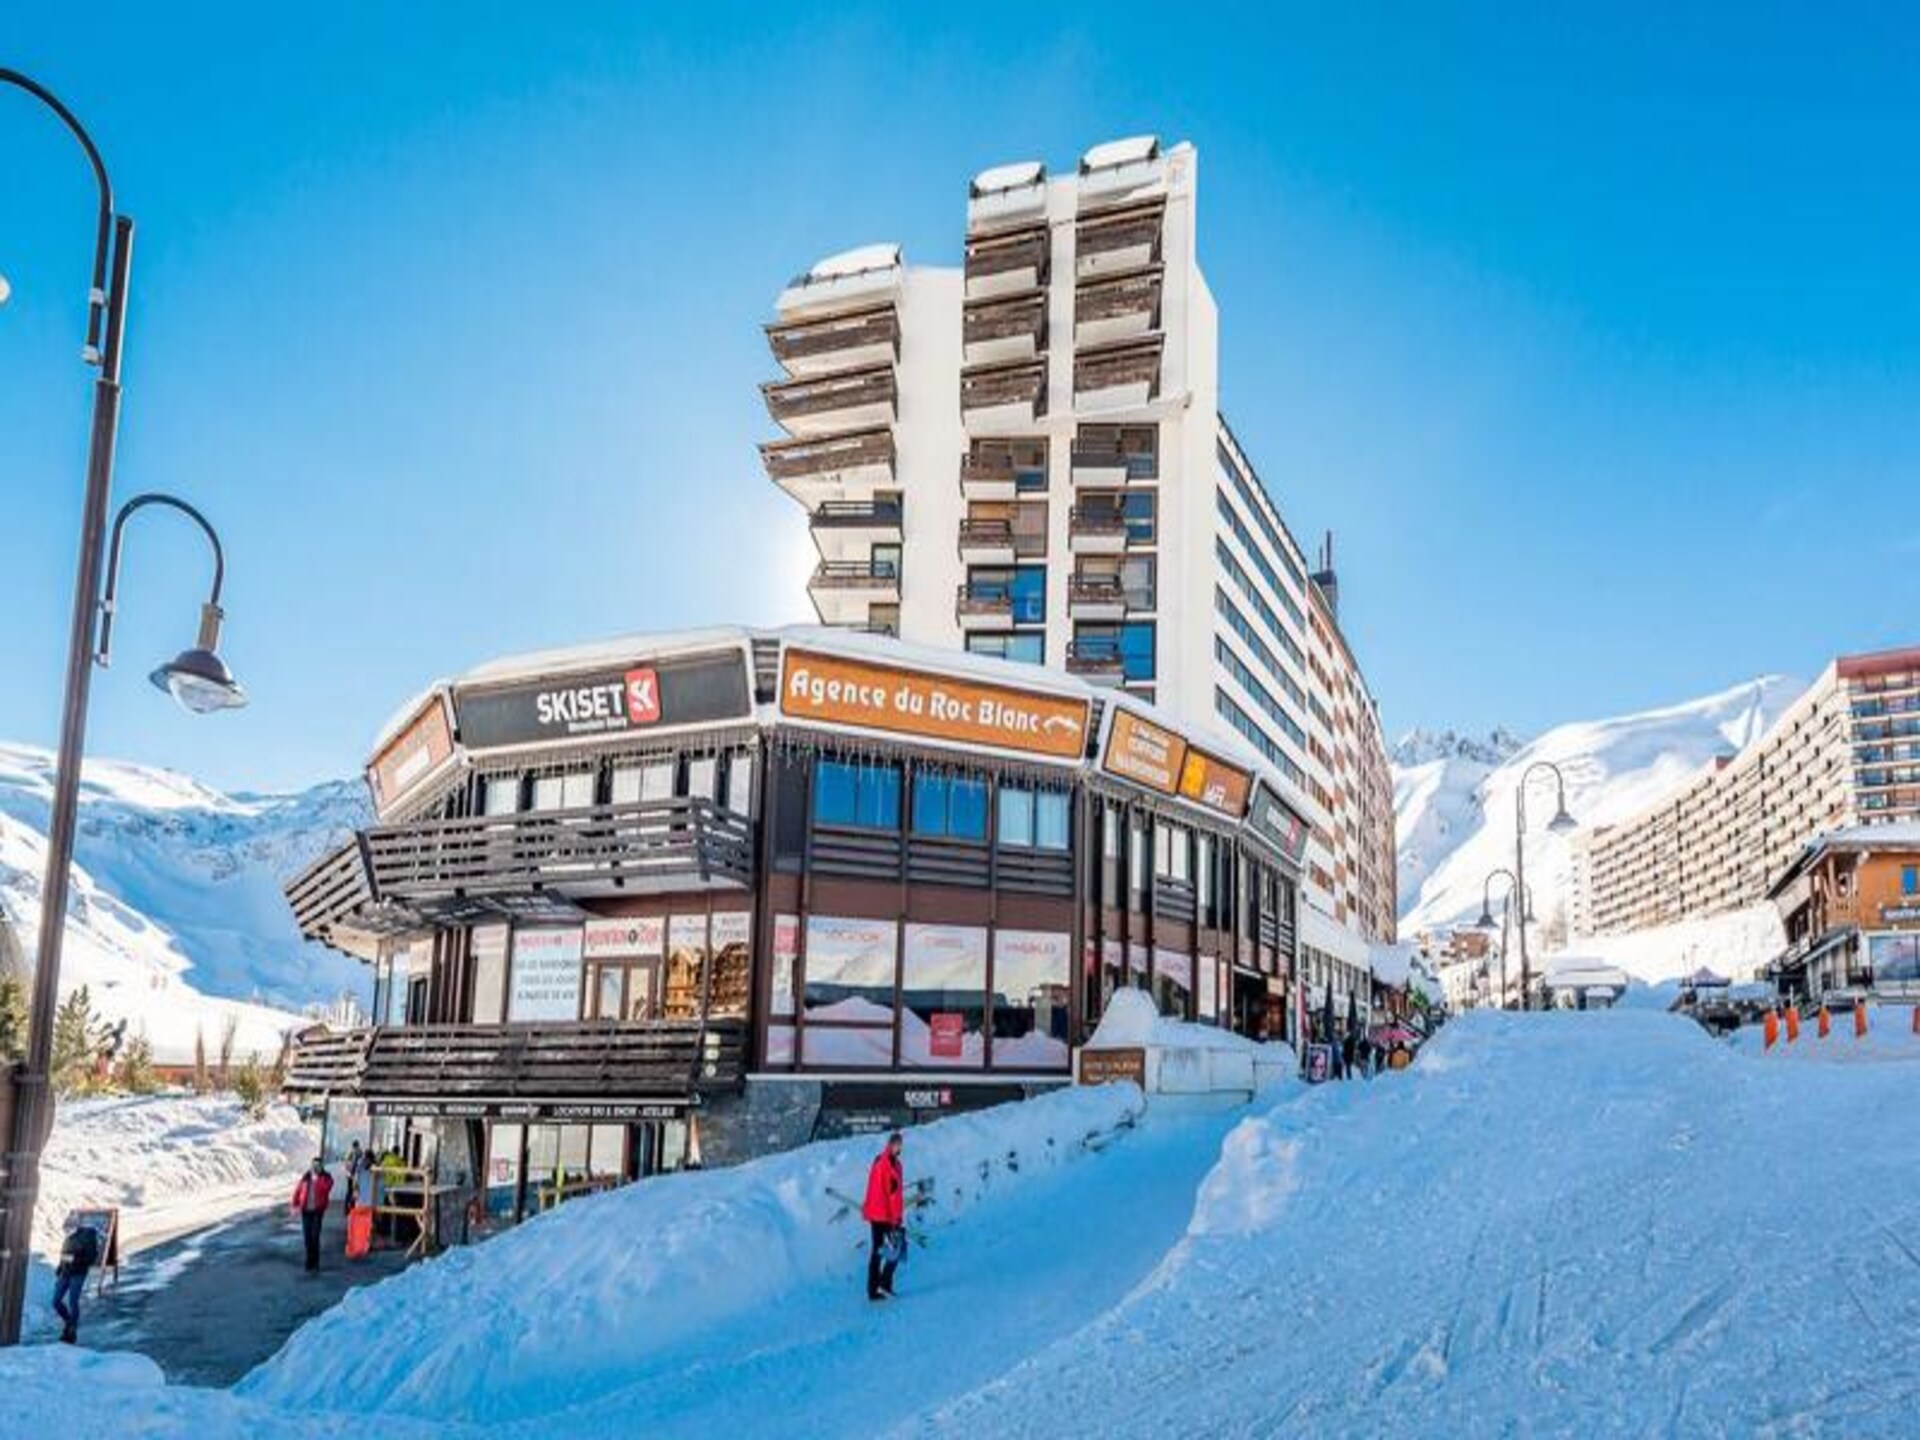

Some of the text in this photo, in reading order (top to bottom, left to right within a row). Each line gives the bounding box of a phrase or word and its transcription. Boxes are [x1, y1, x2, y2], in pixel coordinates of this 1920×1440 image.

[537, 683, 625, 724] SKISET
[789, 669, 1040, 733] Agence du Roc Blanc
